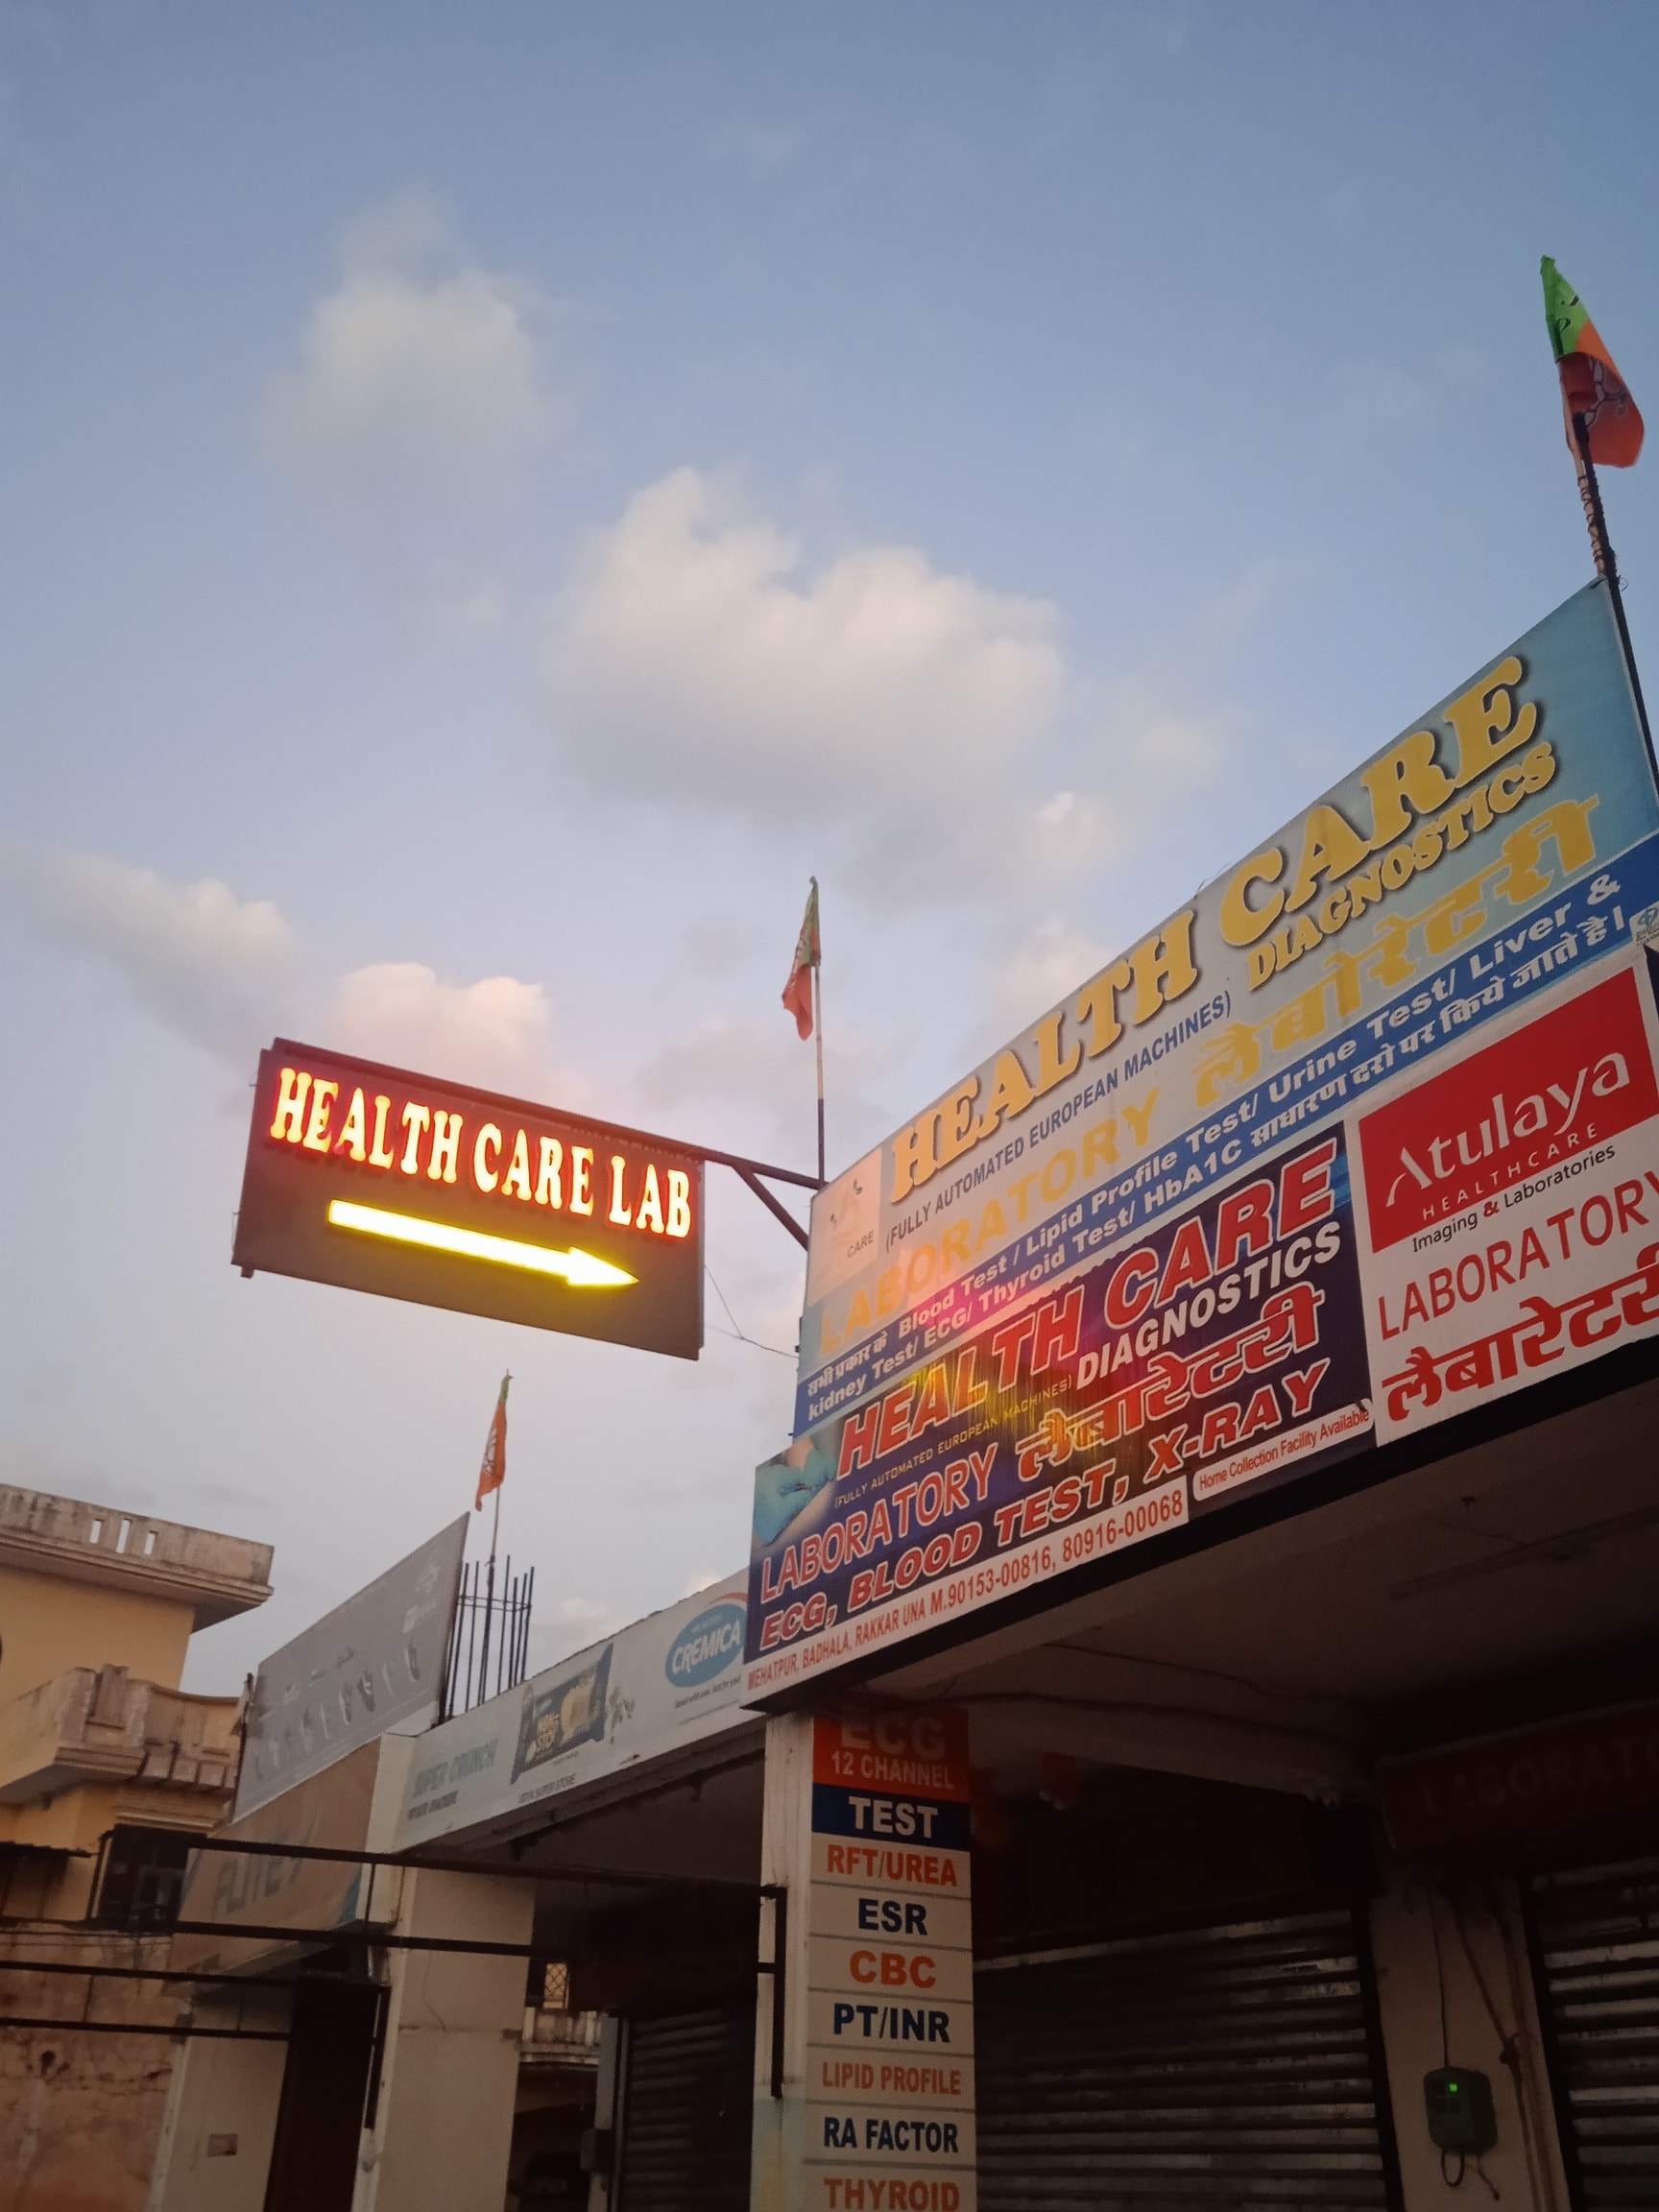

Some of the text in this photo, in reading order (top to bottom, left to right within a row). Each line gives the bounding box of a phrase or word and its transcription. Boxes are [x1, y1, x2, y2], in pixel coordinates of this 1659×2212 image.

[1250, 741, 1555, 991] DIAGNOSTICS
[890, 656, 1536, 1204] HEALTH CARE
[269, 1068, 692, 1238] HEALTH CARE LAB
[885, 990, 1231, 1254] (FULLY AUTOMATED EUROPEAN MACHINES)
[899, 1287, 955, 1335] Blood
[961, 1258, 1008, 1295] Test
[1026, 1203, 1083, 1257] Lipid
[1091, 1150, 1177, 1208] Profile
[1185, 1093, 1259, 1150] Test/
[1268, 1039, 1358, 1103] Urine
[1366, 968, 1455, 1039] Test/
[1469, 902, 1572, 980] Liver
[1587, 875, 1622, 905] &
[1384, 1051, 1631, 1208] Atulaya
[821, 1087, 1160, 1354] LABORATORY
[1411, 1143, 1616, 1253] Imaging & Laboratories
[1422, 1122, 1599, 1221] HEALTHCARE
[808, 1375, 867, 1421] kidney
[872, 1336, 918, 1380] Test/
[924, 1302, 973, 1348] ECG/
[978, 1243, 1066, 1315] Thyroid
[1072, 1200, 1135, 1253] Test/
[1143, 1142, 1243, 1216] HbA1C
[836, 1138, 1337, 1480] HEALTH CARE
[1075, 1221, 1340, 1390] DIAGNOSTICS
[834, 1375, 1072, 1509] (FULLY AUTOMATED EUROPEAN MACHINES)
[1199, 1409, 1370, 1491] Home Collection Facility Available
[759, 1357, 1331, 1651] ECG, BLOOD TEST, X-RAY
[760, 1443, 998, 1604] LABORATORY
[855, 1609, 900, 1647] RAKKAR
[902, 1598, 926, 1626] UNA
[1062, 1488, 1184, 1563] 80916-00068
[672, 1620, 740, 1674] CREMICA
[830, 1750, 955, 1790] 12 CHANNEL
[841, 1712, 945, 1760] ECG
[826, 1843, 958, 1887] RFT/UREA
[848, 1795, 938, 1839] TEST
[849, 1950, 937, 1989] CBC
[857, 1897, 928, 1936] ESR
[821, 2060, 962, 2096] LIPID PROFILE
[833, 2003, 950, 2043] PT/INR
[823, 2177, 960, 2212] THYROID
[824, 2115, 959, 2152] RA FACTOR
